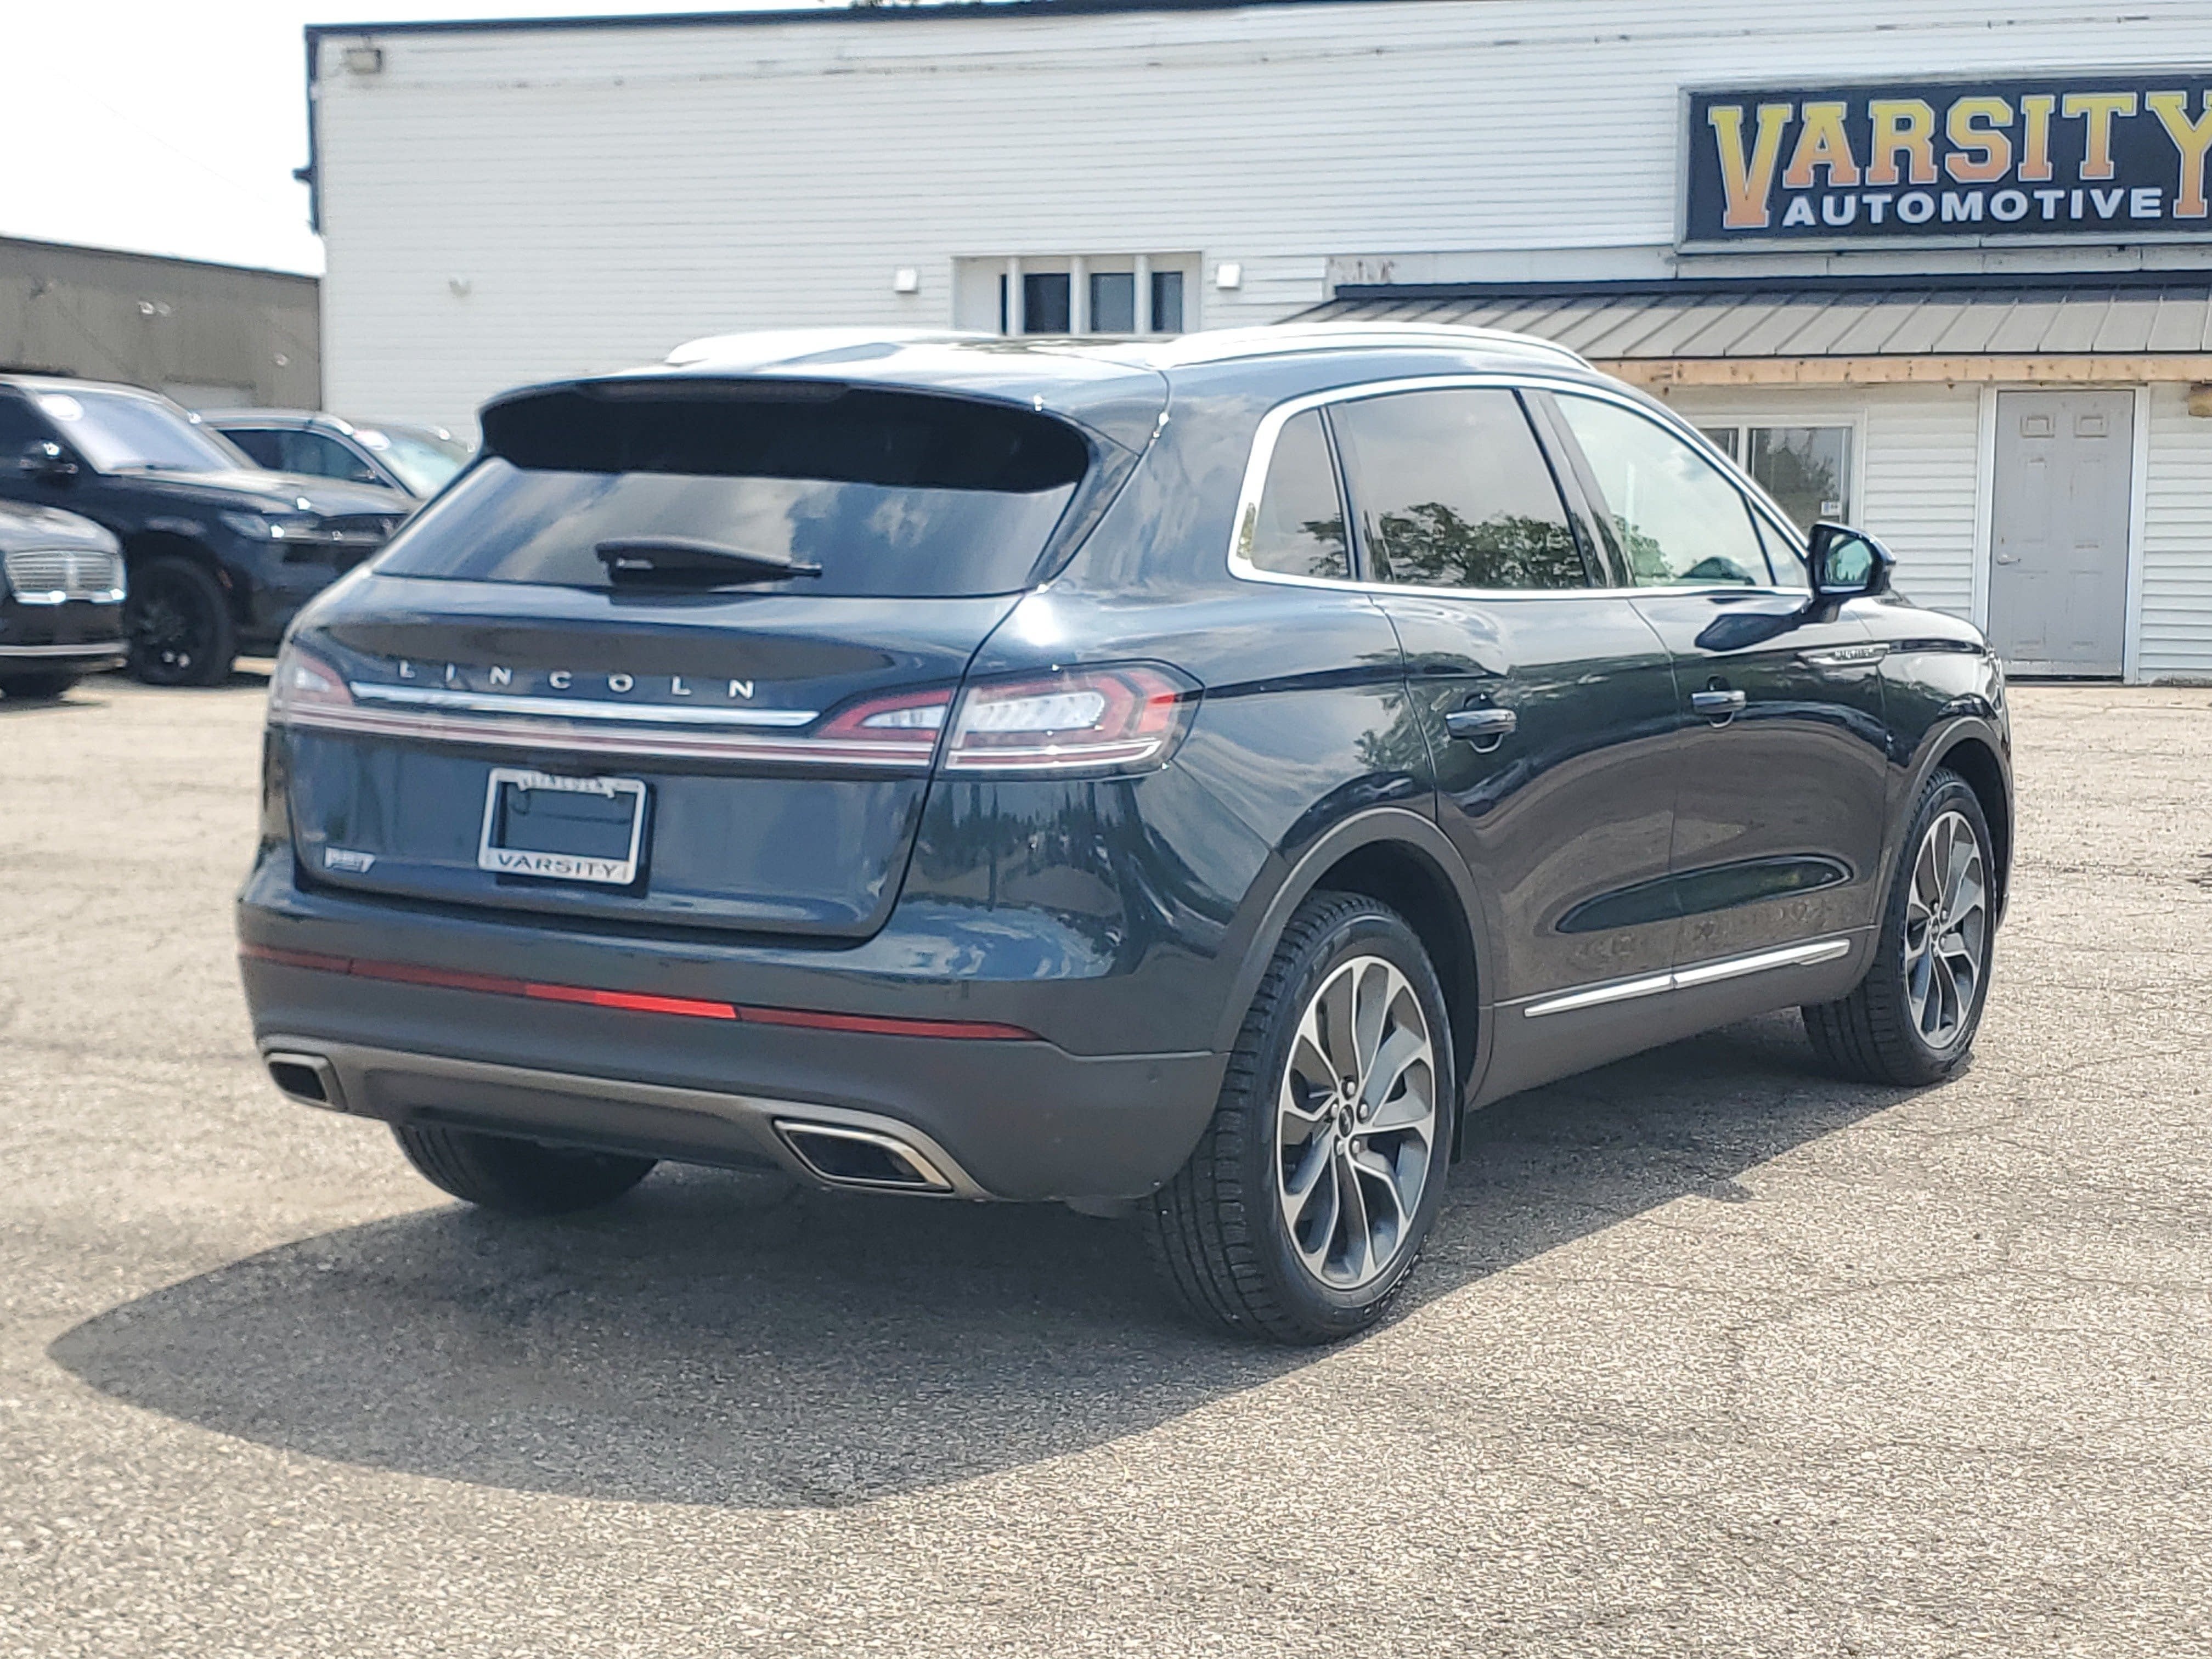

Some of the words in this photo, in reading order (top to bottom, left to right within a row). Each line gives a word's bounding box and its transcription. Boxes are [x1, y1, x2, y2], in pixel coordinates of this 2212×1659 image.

[1708, 91, 2212, 228] VARSITY
[1782, 188, 2162, 227] AUTOMOTIVE
[399, 661, 755, 699] LINCOLN
[498, 854, 617, 878] VARSITY
